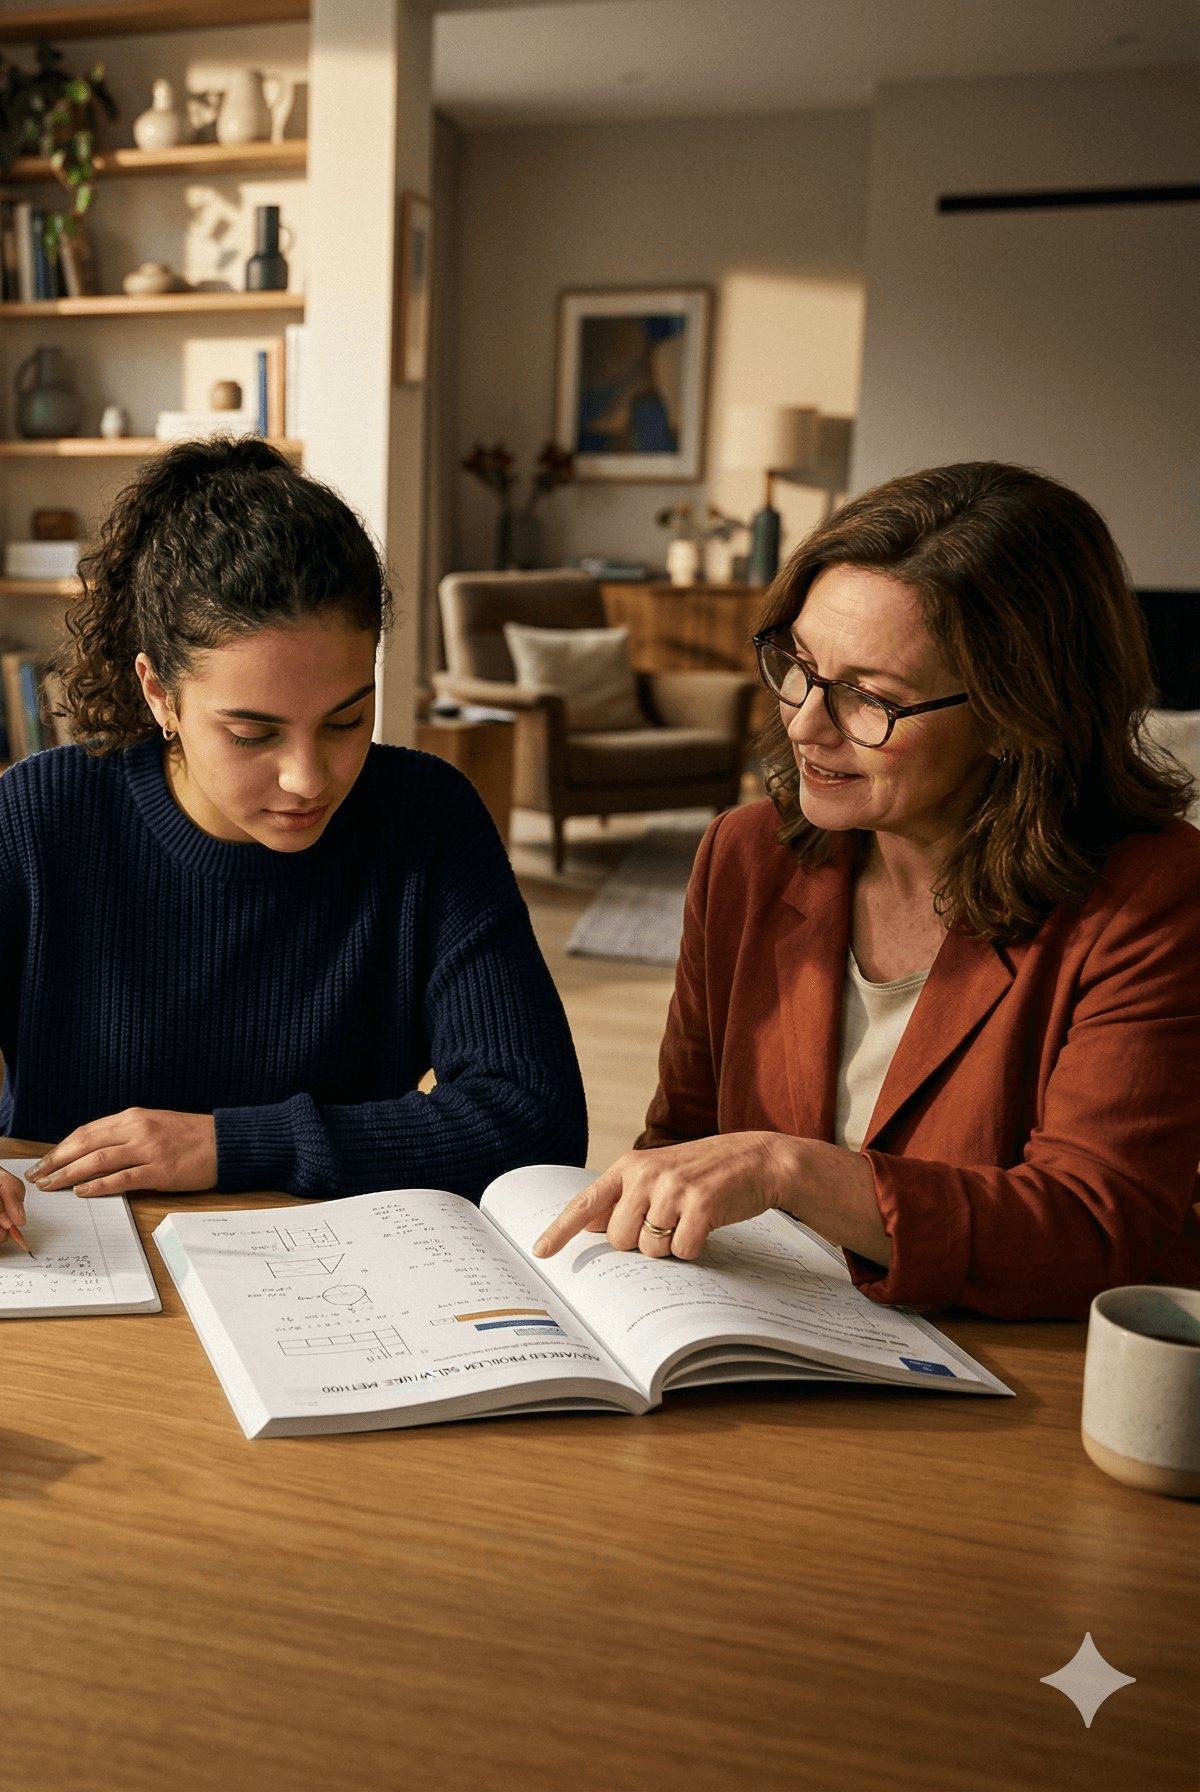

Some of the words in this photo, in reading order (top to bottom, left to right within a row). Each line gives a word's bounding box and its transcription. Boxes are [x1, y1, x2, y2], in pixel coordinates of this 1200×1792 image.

[463, 1354, 527, 1371] PROBLEM
[529, 1351, 600, 1362] ADVANCED
[321, 1381, 379, 1394] METHOD
